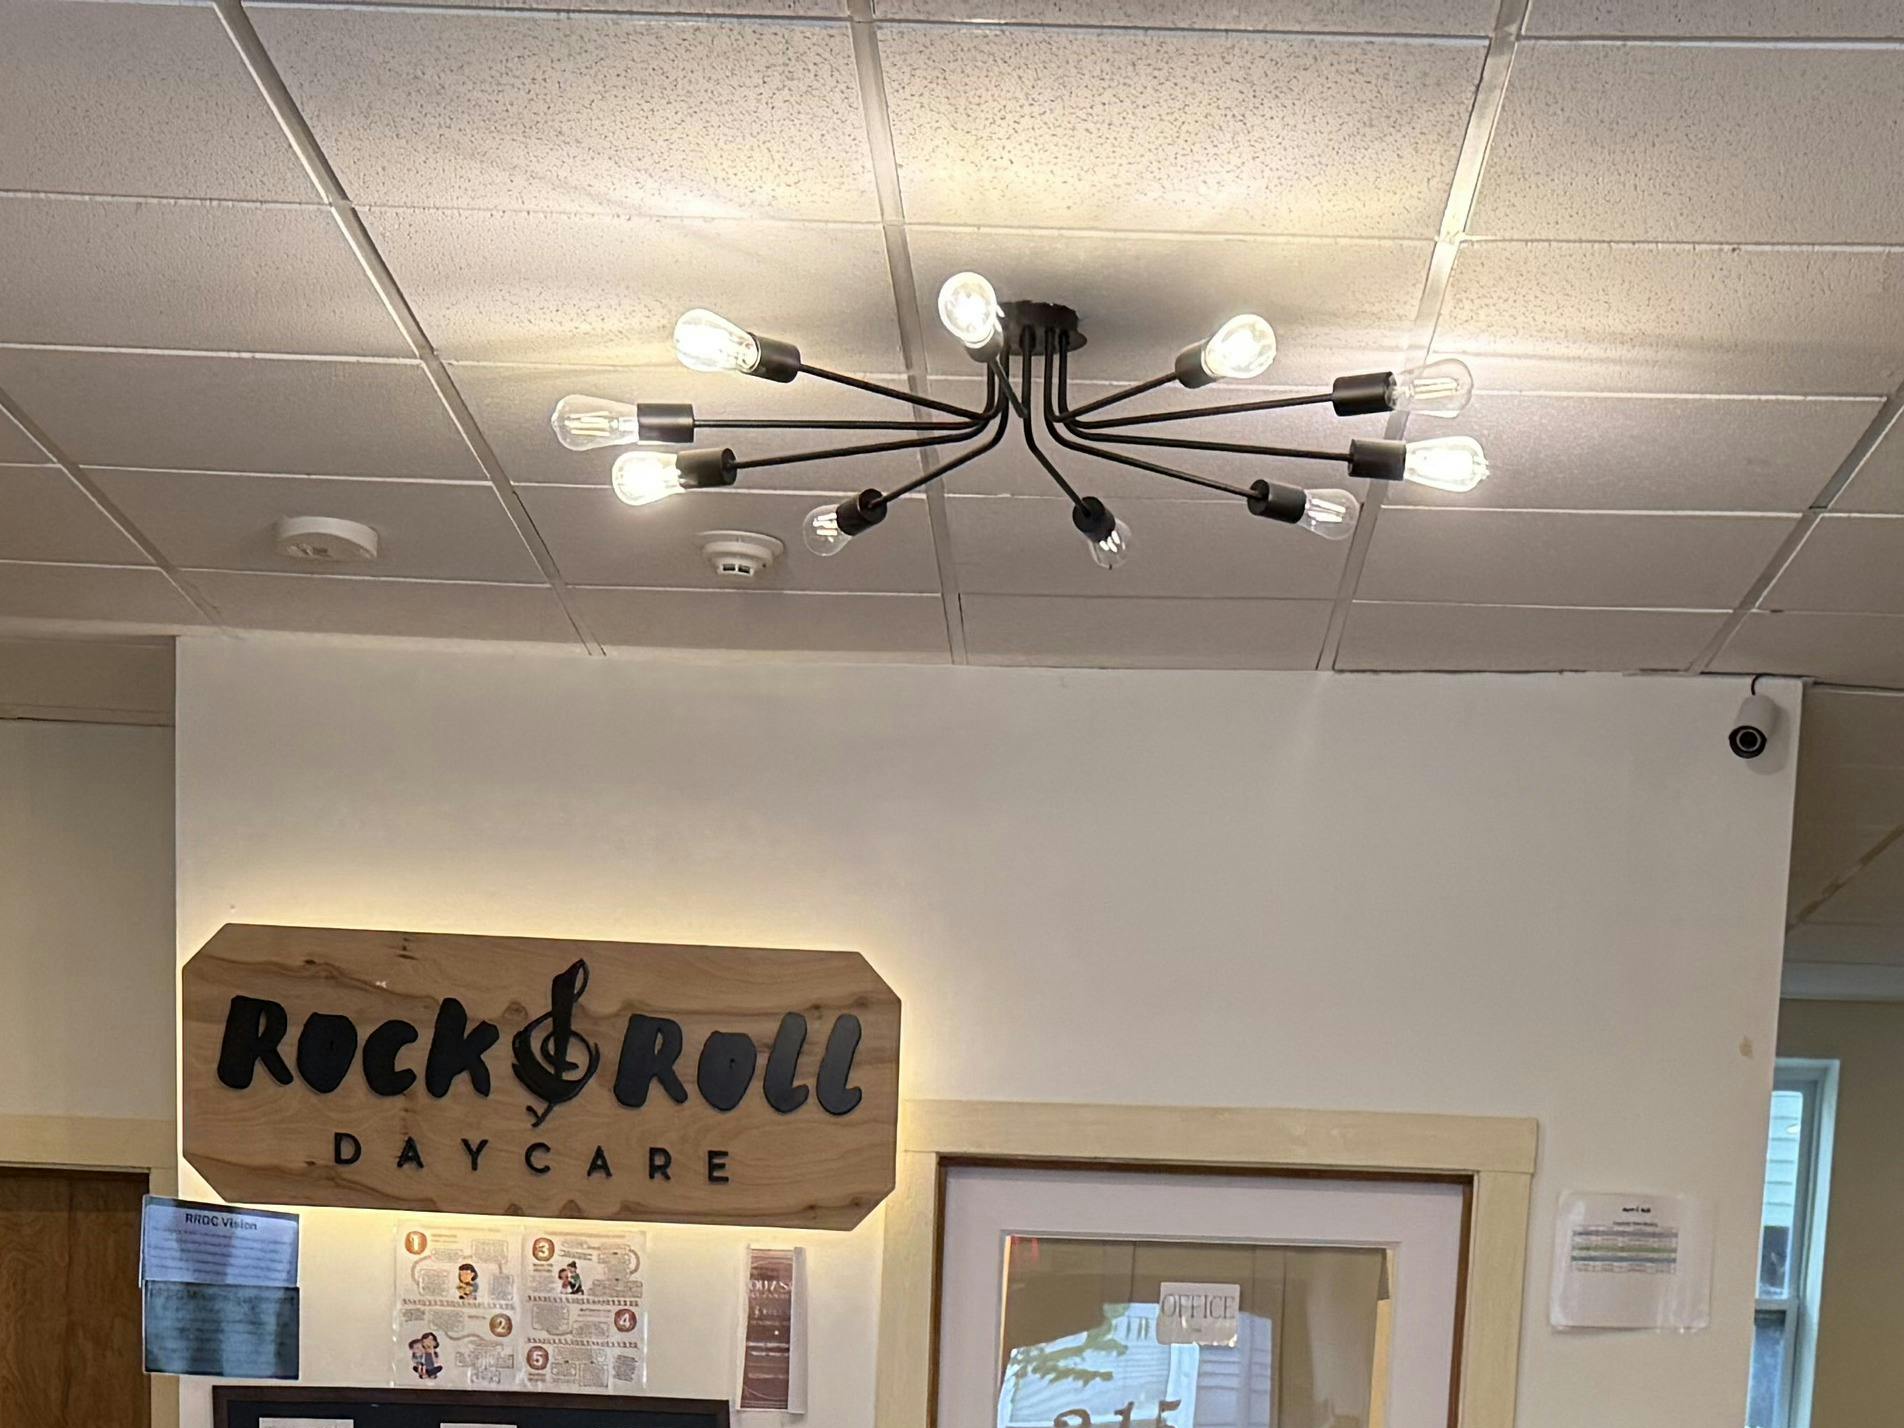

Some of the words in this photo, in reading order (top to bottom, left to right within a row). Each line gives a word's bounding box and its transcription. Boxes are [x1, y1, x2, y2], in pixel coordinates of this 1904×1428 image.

[332, 1130, 730, 1184] DAYCARE
[539, 1241, 549, 1257] 3
[1161, 1293, 1236, 1319] OFFICE
[496, 1317, 507, 1332] 2
[620, 1313, 631, 1328] 4
[532, 1351, 544, 1366] 5
